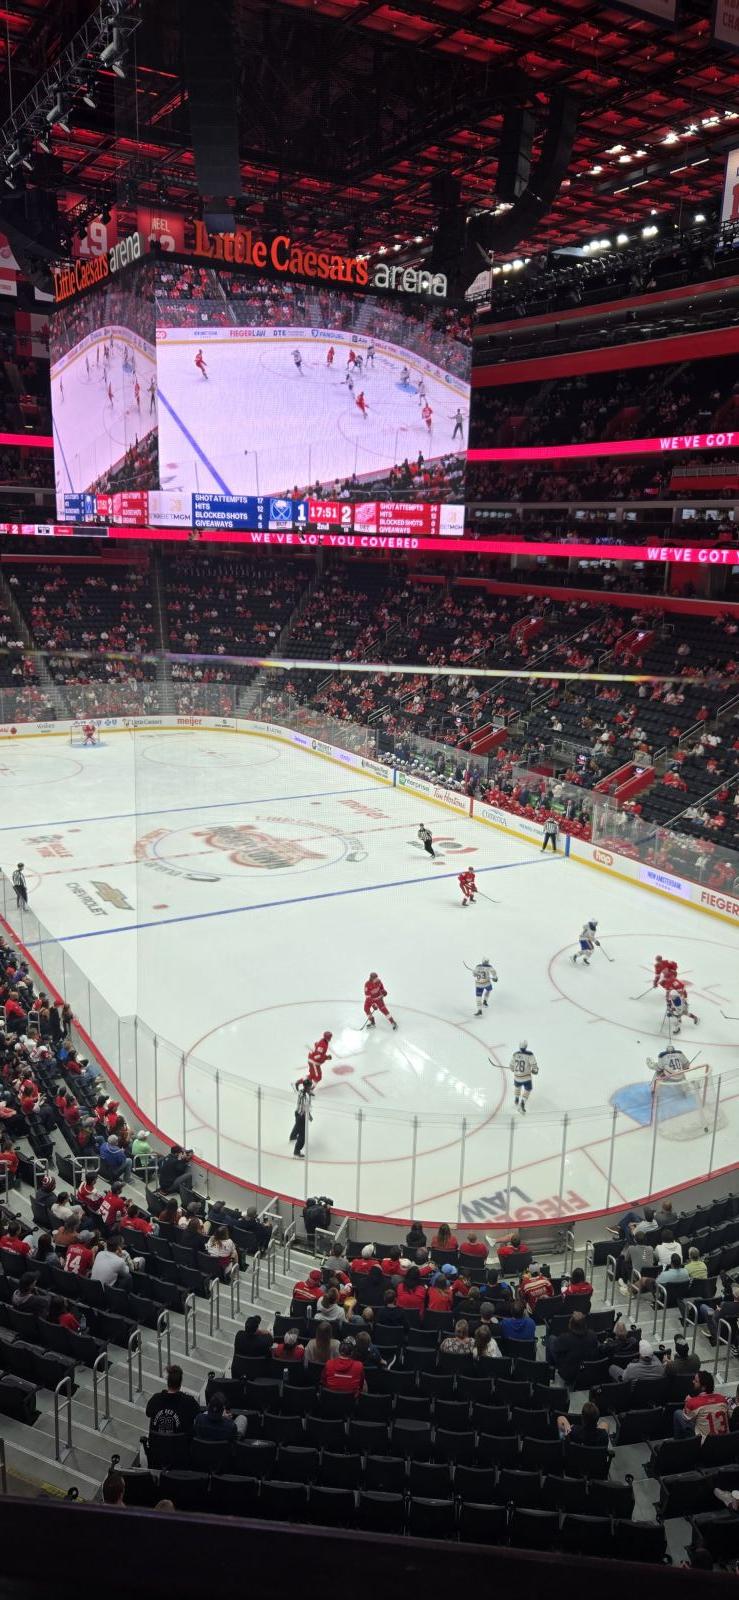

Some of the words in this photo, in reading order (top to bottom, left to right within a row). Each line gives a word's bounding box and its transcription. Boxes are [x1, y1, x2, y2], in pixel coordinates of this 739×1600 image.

[109, 231, 141, 273] arena
[193, 220, 267, 267] Little
[271, 235, 369, 286] Caesars
[374, 263, 448, 297] arena
[75, 254, 109, 291] Caesars
[660, 435, 700, 449] WE'VE
[706, 433, 734, 446] GOT
[195, 494, 214, 502] SHOT
[213, 495, 248, 503] ATTEMPTS
[195, 511, 226, 519] BLOCKED
[226, 512, 248, 520] SHOTS
[297, 503, 307, 521] 1
[310, 506, 337, 518] 17:51
[341, 506, 352, 522] 2
[195, 520, 234, 528] GIVEAWAYS
[250, 532, 293, 544] WE'VE
[329, 535, 355, 547] YOU
[361, 536, 419, 549] COVERED
[647, 548, 692, 561] WE'VE
[698, 549, 729, 562] GOT
[65, 881, 108, 917] CHEVROLET
[701, 891, 739, 916] FIEGER
[63, 1252, 82, 1275] 14
[704, 1410, 728, 1435] 13
